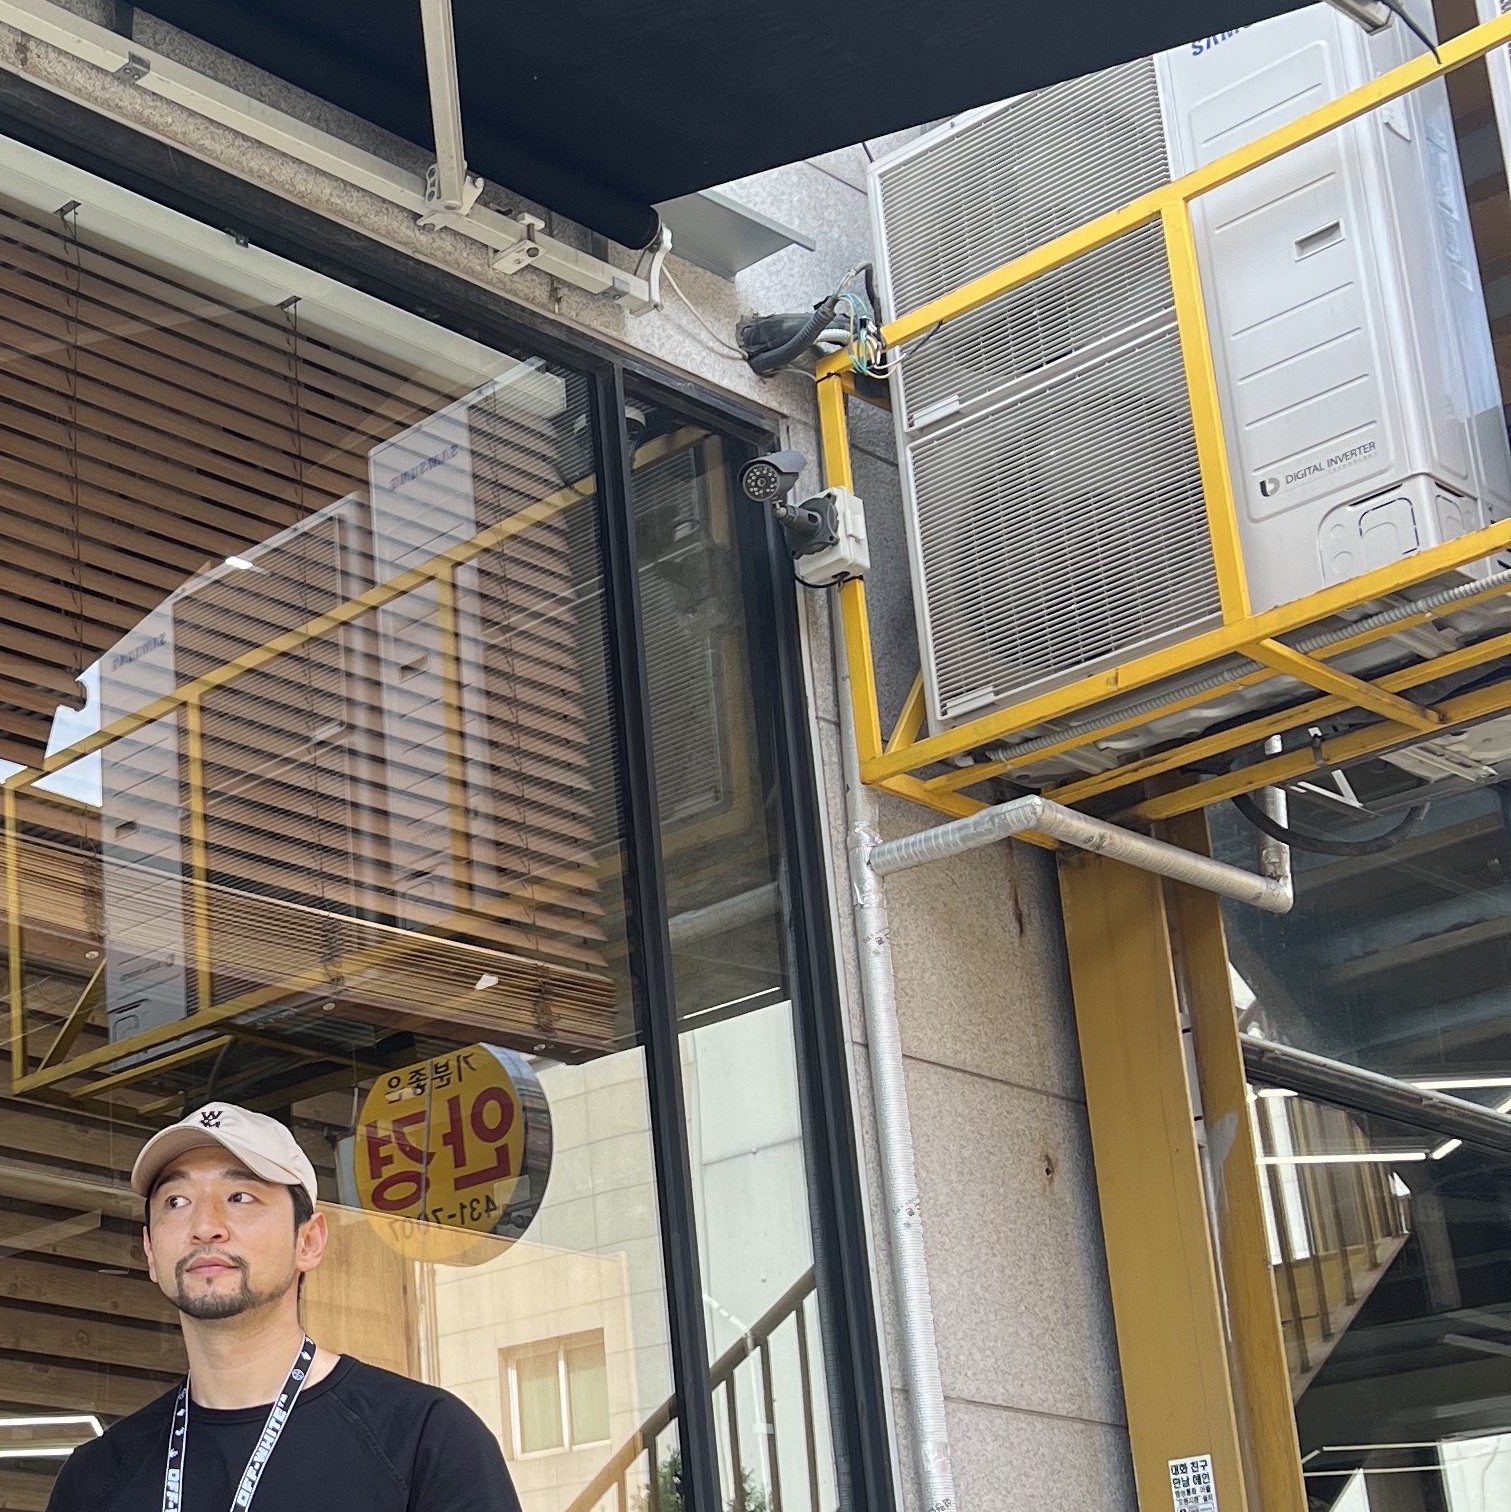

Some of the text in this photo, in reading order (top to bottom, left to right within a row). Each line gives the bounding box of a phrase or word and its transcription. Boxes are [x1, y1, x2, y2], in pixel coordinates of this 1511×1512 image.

[1285, 462, 1325, 484] DIGITAL
[1327, 441, 1376, 468] INVERTER
[1171, 1460, 1208, 1475] 대화 친구
